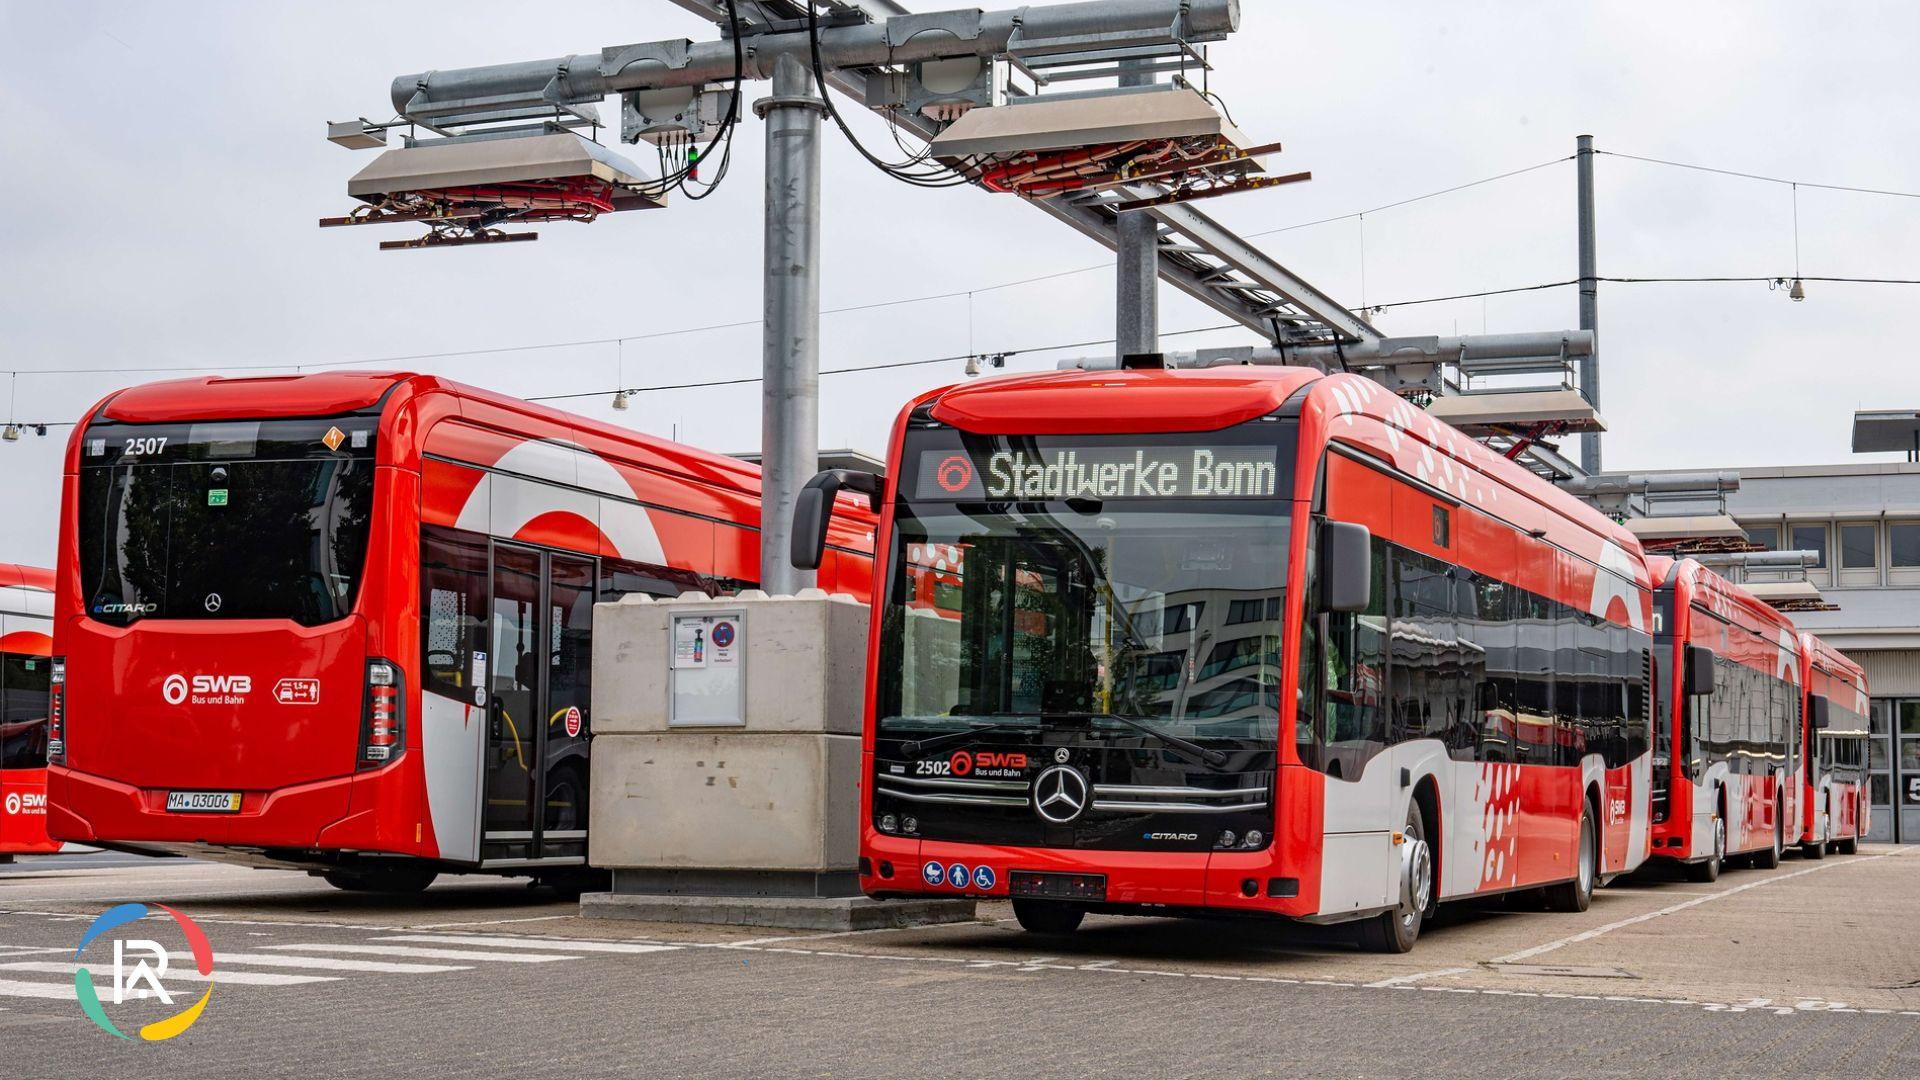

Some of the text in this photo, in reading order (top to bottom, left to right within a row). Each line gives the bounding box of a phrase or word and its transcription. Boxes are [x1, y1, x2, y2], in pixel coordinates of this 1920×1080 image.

[125, 437, 168, 456] 2507
[988, 449, 1276, 497] Stadtwerke Bonn
[93, 602, 157, 613] eCITARO
[192, 675, 252, 693] SWB
[191, 695, 245, 705] Bus und Bahn
[976, 752, 1027, 768] SWB
[916, 761, 951, 775] 2502
[975, 767, 1021, 777] Bus und Bahn
[22, 794, 47, 807] SW
[168, 793, 184, 808] MA
[191, 793, 230, 808] 03006
[1142, 832, 1199, 841] eCITARO
